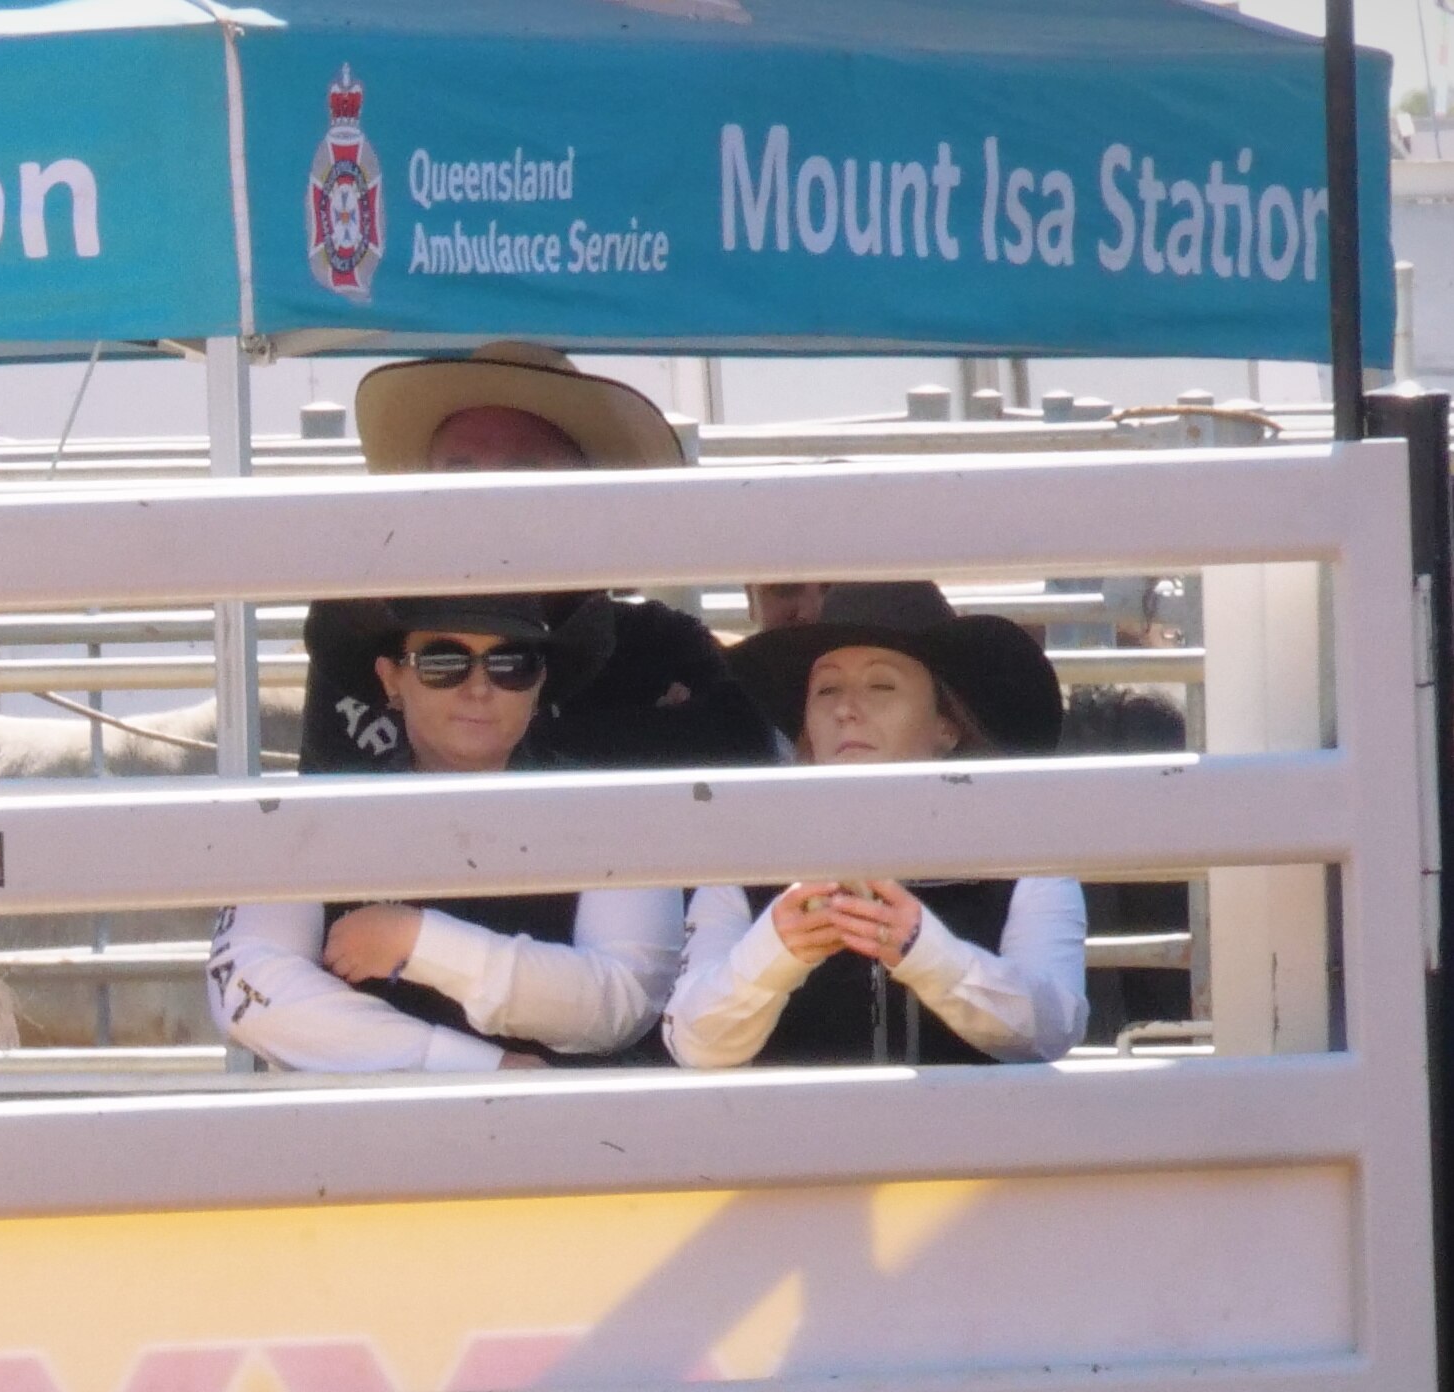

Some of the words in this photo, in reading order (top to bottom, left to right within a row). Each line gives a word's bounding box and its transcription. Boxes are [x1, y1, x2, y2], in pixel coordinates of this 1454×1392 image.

[409, 147, 574, 209] Queensland
[720, 124, 960, 260] Mount
[982, 136, 1075, 266] Isa
[408, 221, 561, 274] Ambulance
[567, 217, 668, 273] Service
